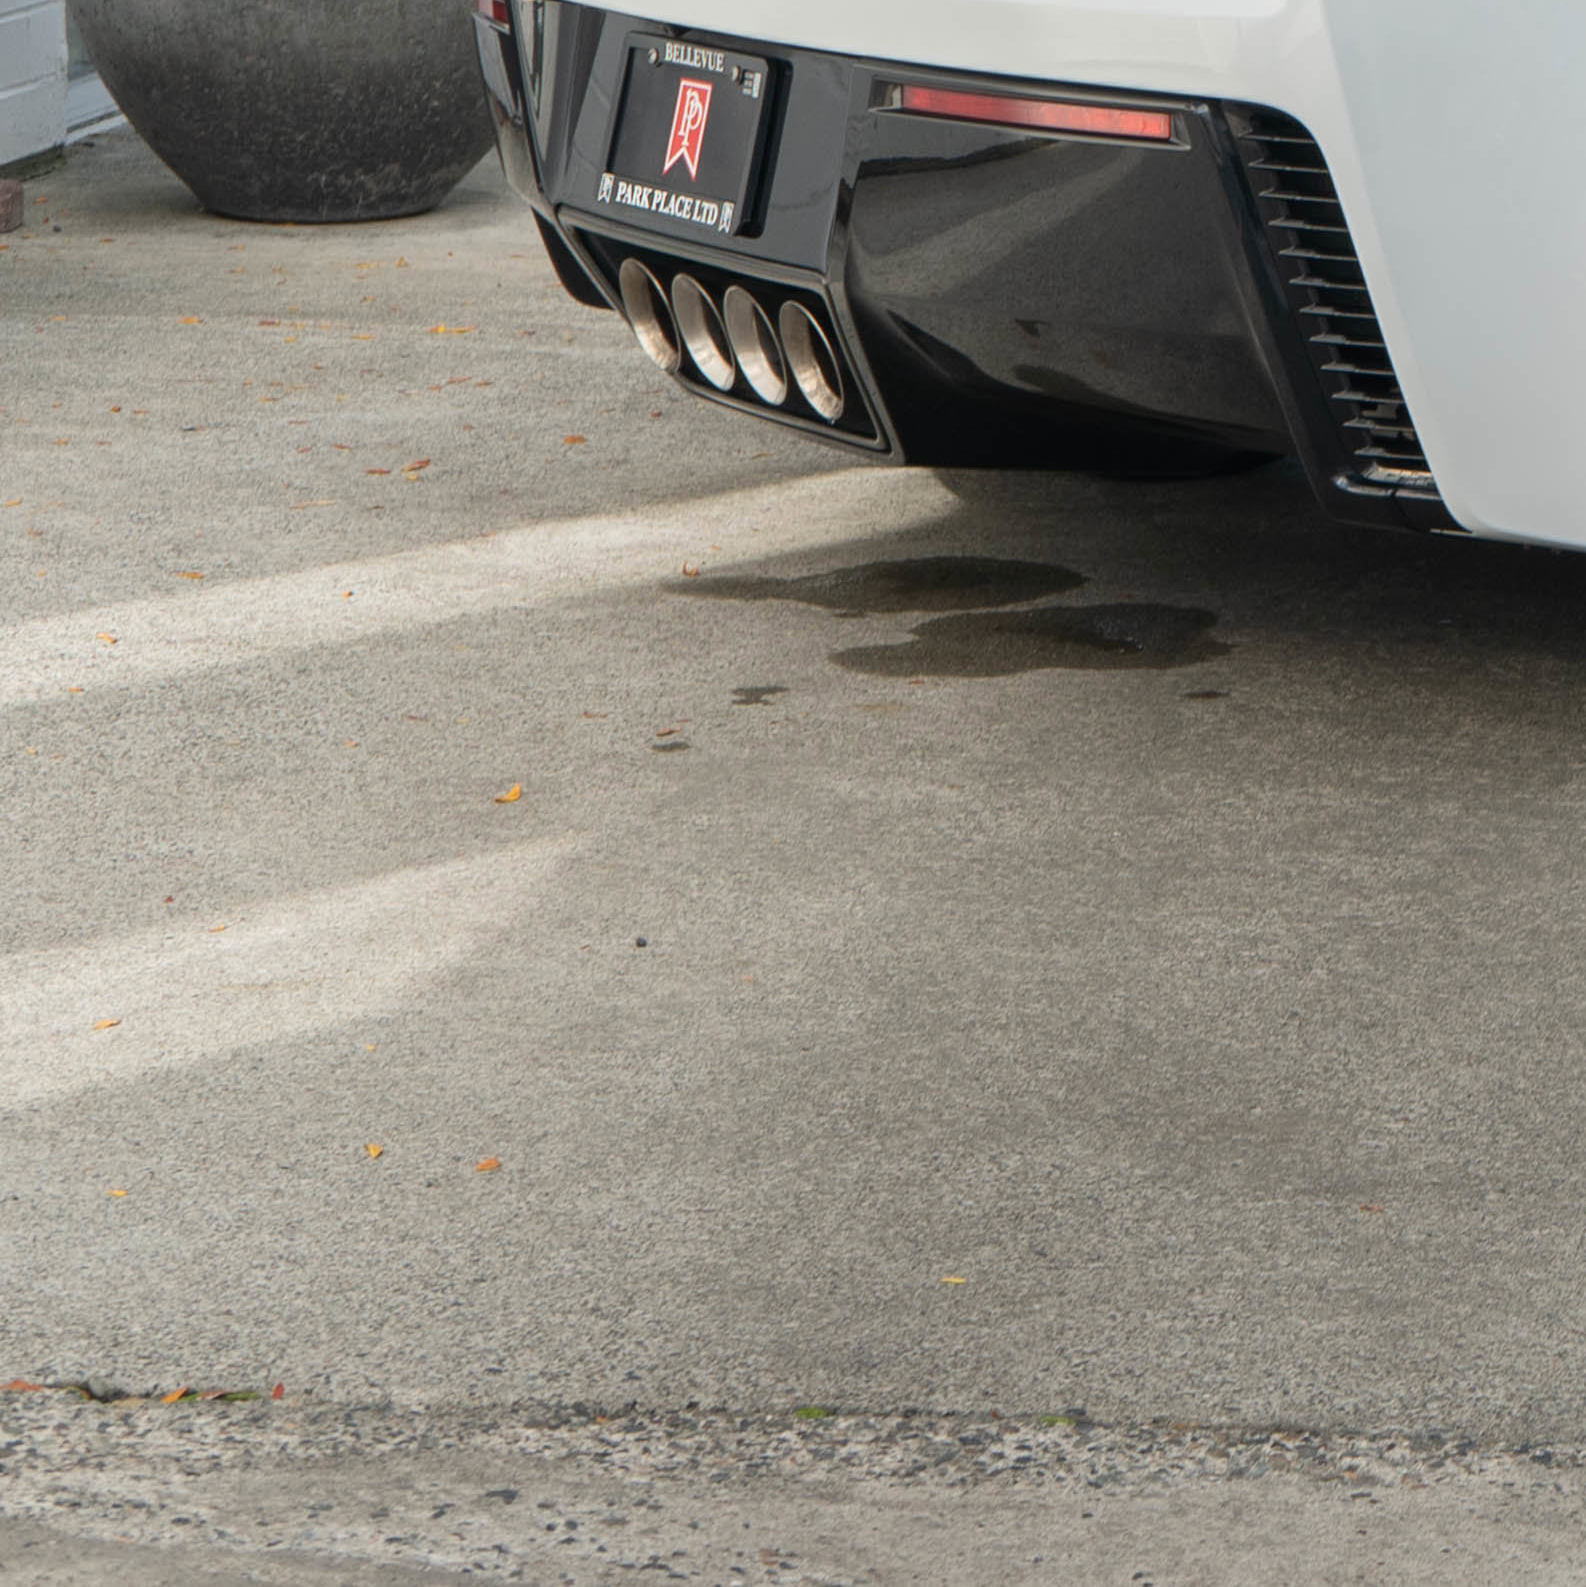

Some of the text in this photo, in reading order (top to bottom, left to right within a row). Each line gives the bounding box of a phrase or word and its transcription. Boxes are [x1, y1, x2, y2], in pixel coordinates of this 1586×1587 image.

[664, 42, 725, 72] BELLEVUE
[615, 181, 719, 226] PARK PLACE LTD
